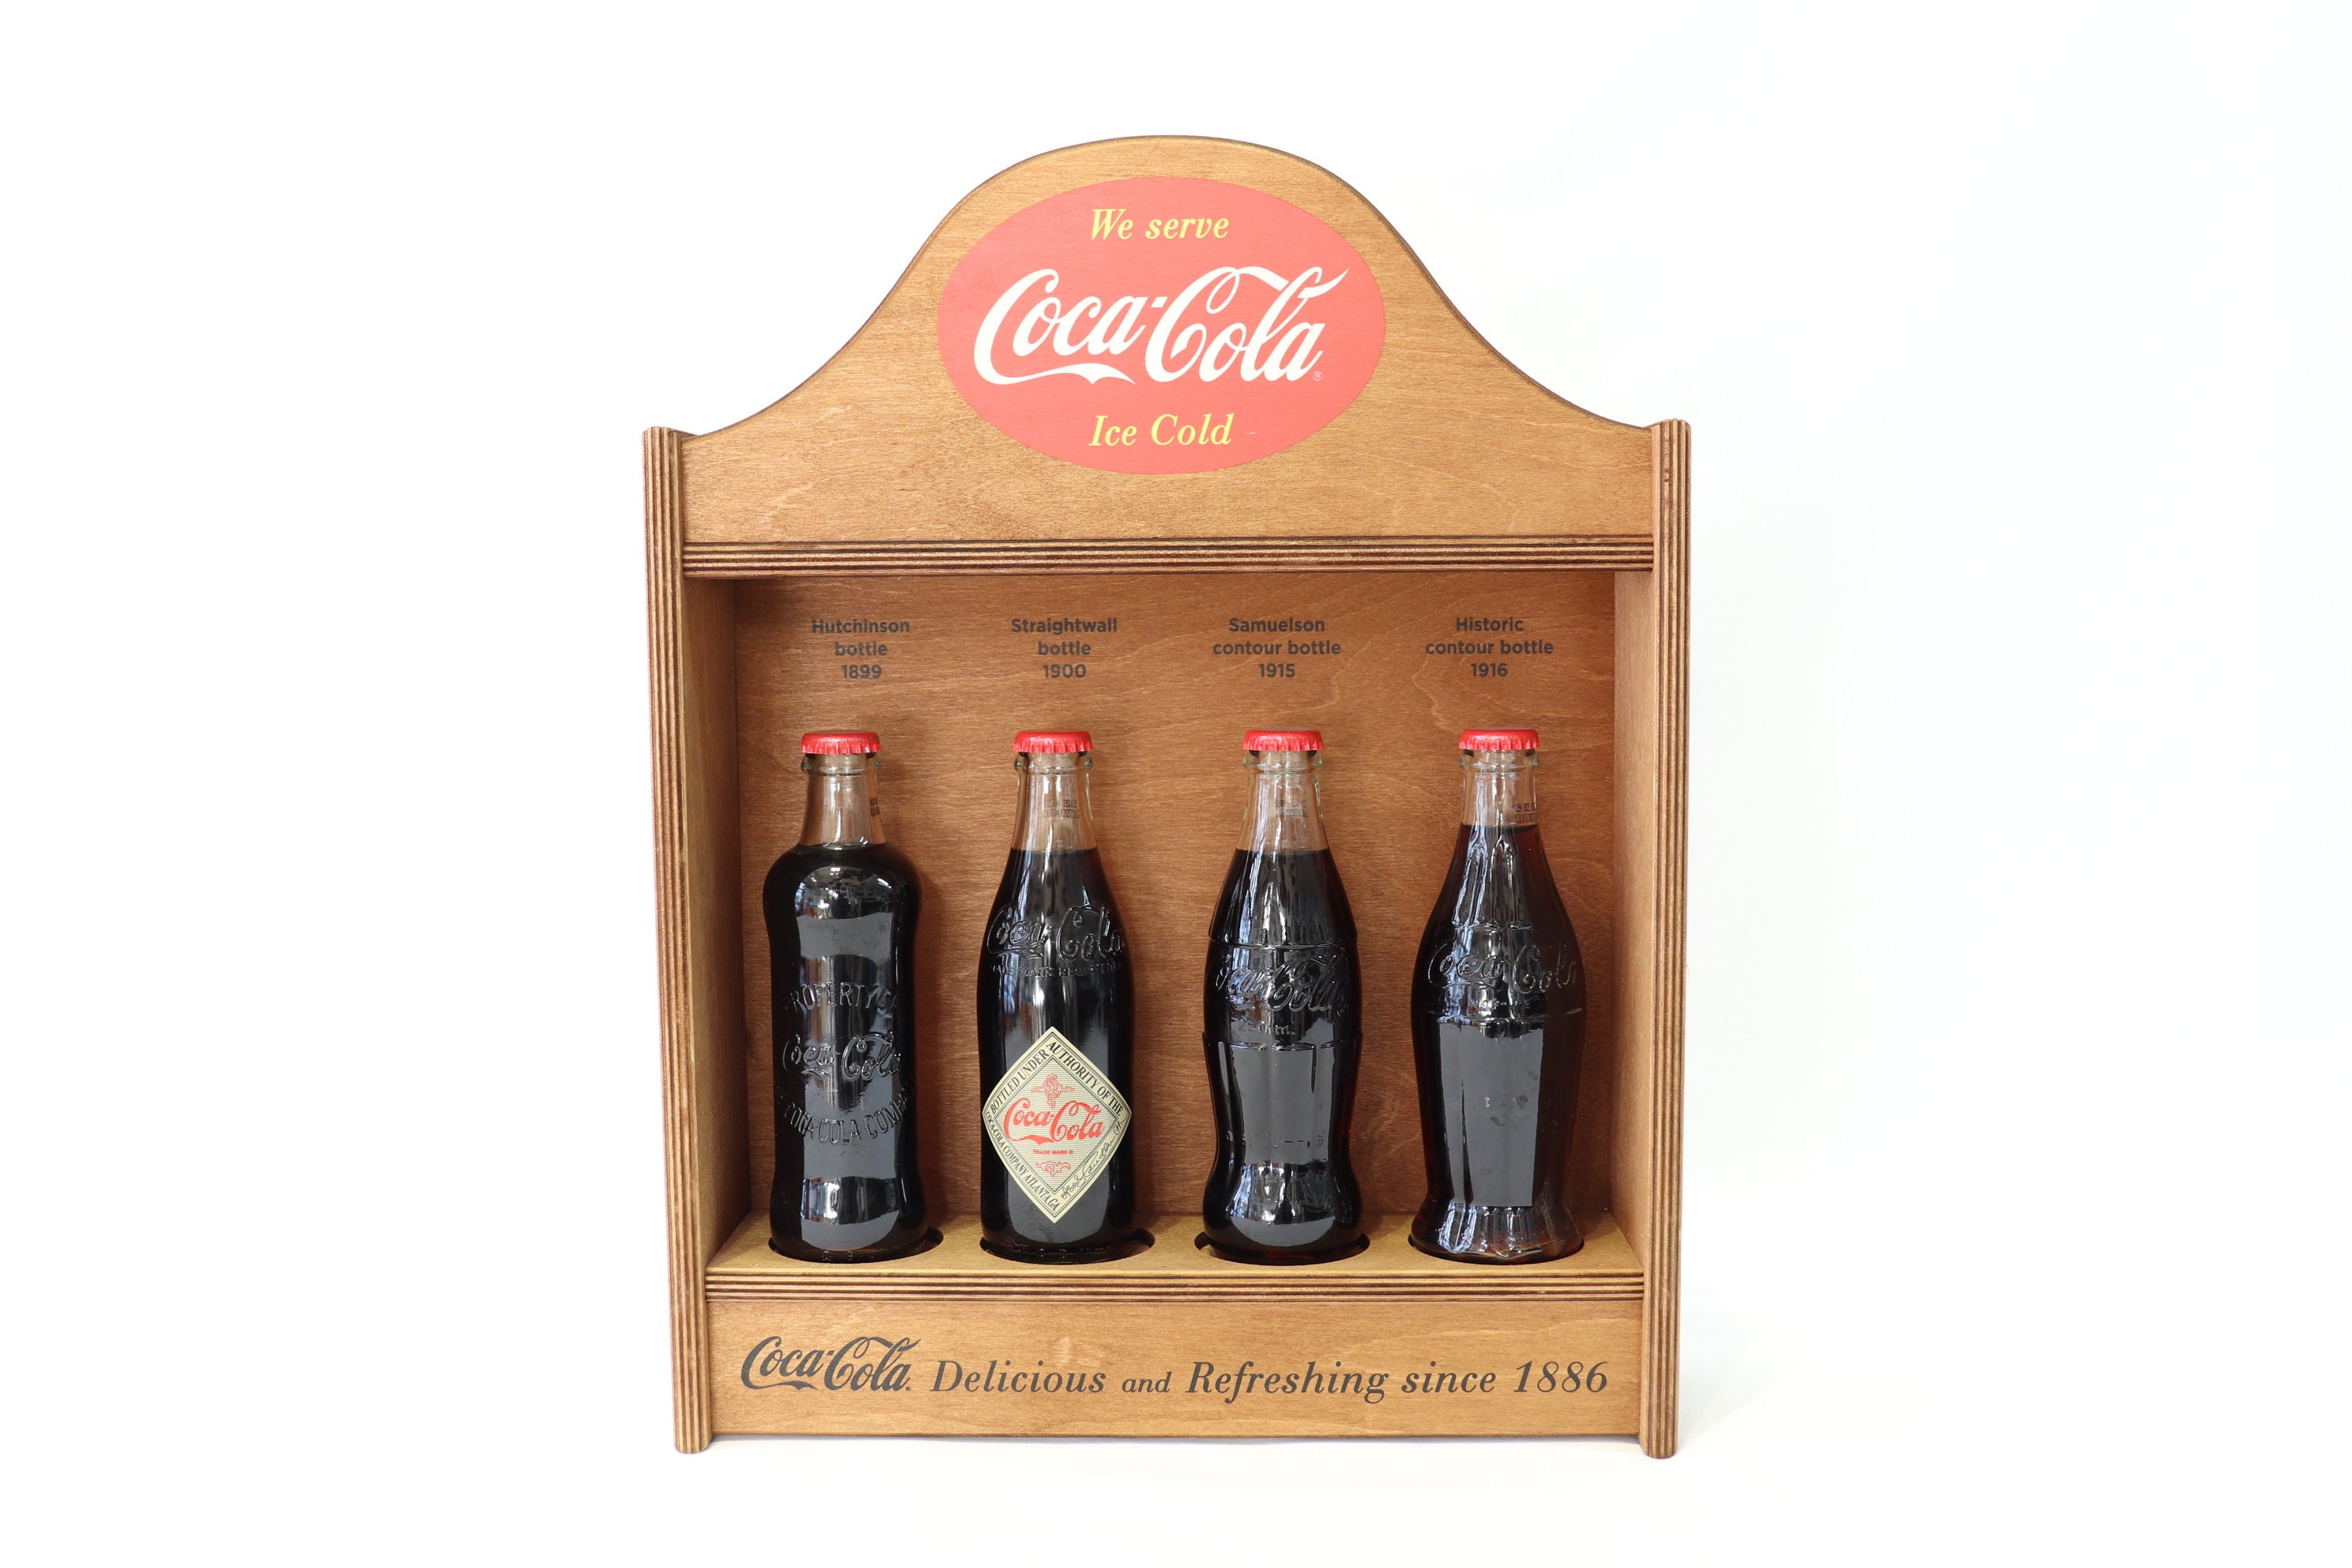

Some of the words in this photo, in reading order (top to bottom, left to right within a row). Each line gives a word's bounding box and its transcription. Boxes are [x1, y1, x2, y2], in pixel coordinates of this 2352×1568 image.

[1091, 209, 1133, 239] We
[1145, 217, 1229, 239] serve
[974, 266, 1350, 385] Coca-Cola
[1088, 415, 1137, 447] Ice
[1151, 413, 1234, 446] Cold
[812, 619, 910, 634] Hutchinson
[1012, 618, 1118, 635] Straightwall
[1229, 617, 1325, 632] Samuelson
[1456, 616, 1524, 631] Historic
[835, 642, 888, 657] bottle
[1038, 641, 1091, 656] bottle
[1213, 642, 1282, 655] contour
[1288, 641, 1341, 655] bottle
[1426, 641, 1494, 654] contour
[1500, 640, 1554, 654] bottle
[842, 664, 883, 679] 1899
[1043, 664, 1087, 678] 1900
[1259, 663, 1295, 678] 1915
[1471, 662, 1508, 677] 1916
[1213, 955, 1341, 1012] oca-Cola
[790, 981, 880, 1013] ROPERTY
[990, 1076, 1020, 1114] BOTTLED
[1017, 1049, 1050, 1080] UNDER
[1046, 1042, 1101, 1090] AUTHORITY
[1097, 1086, 1112, 1100] OF
[1108, 1095, 1124, 1117] THE
[1003, 1098, 1104, 1145] Coca-Cola
[986, 1110, 1007, 1148] COCA-COLA
[1003, 1144, 1030, 1177] COMPANY
[740, 1336, 922, 1391] Coca-Cola
[929, 1359, 1106, 1393] Delicious
[1121, 1370, 1172, 1393] and
[1185, 1360, 1389, 1404] Refreshing
[1400, 1361, 1496, 1393] since
[1513, 1360, 1608, 1393] 1886
